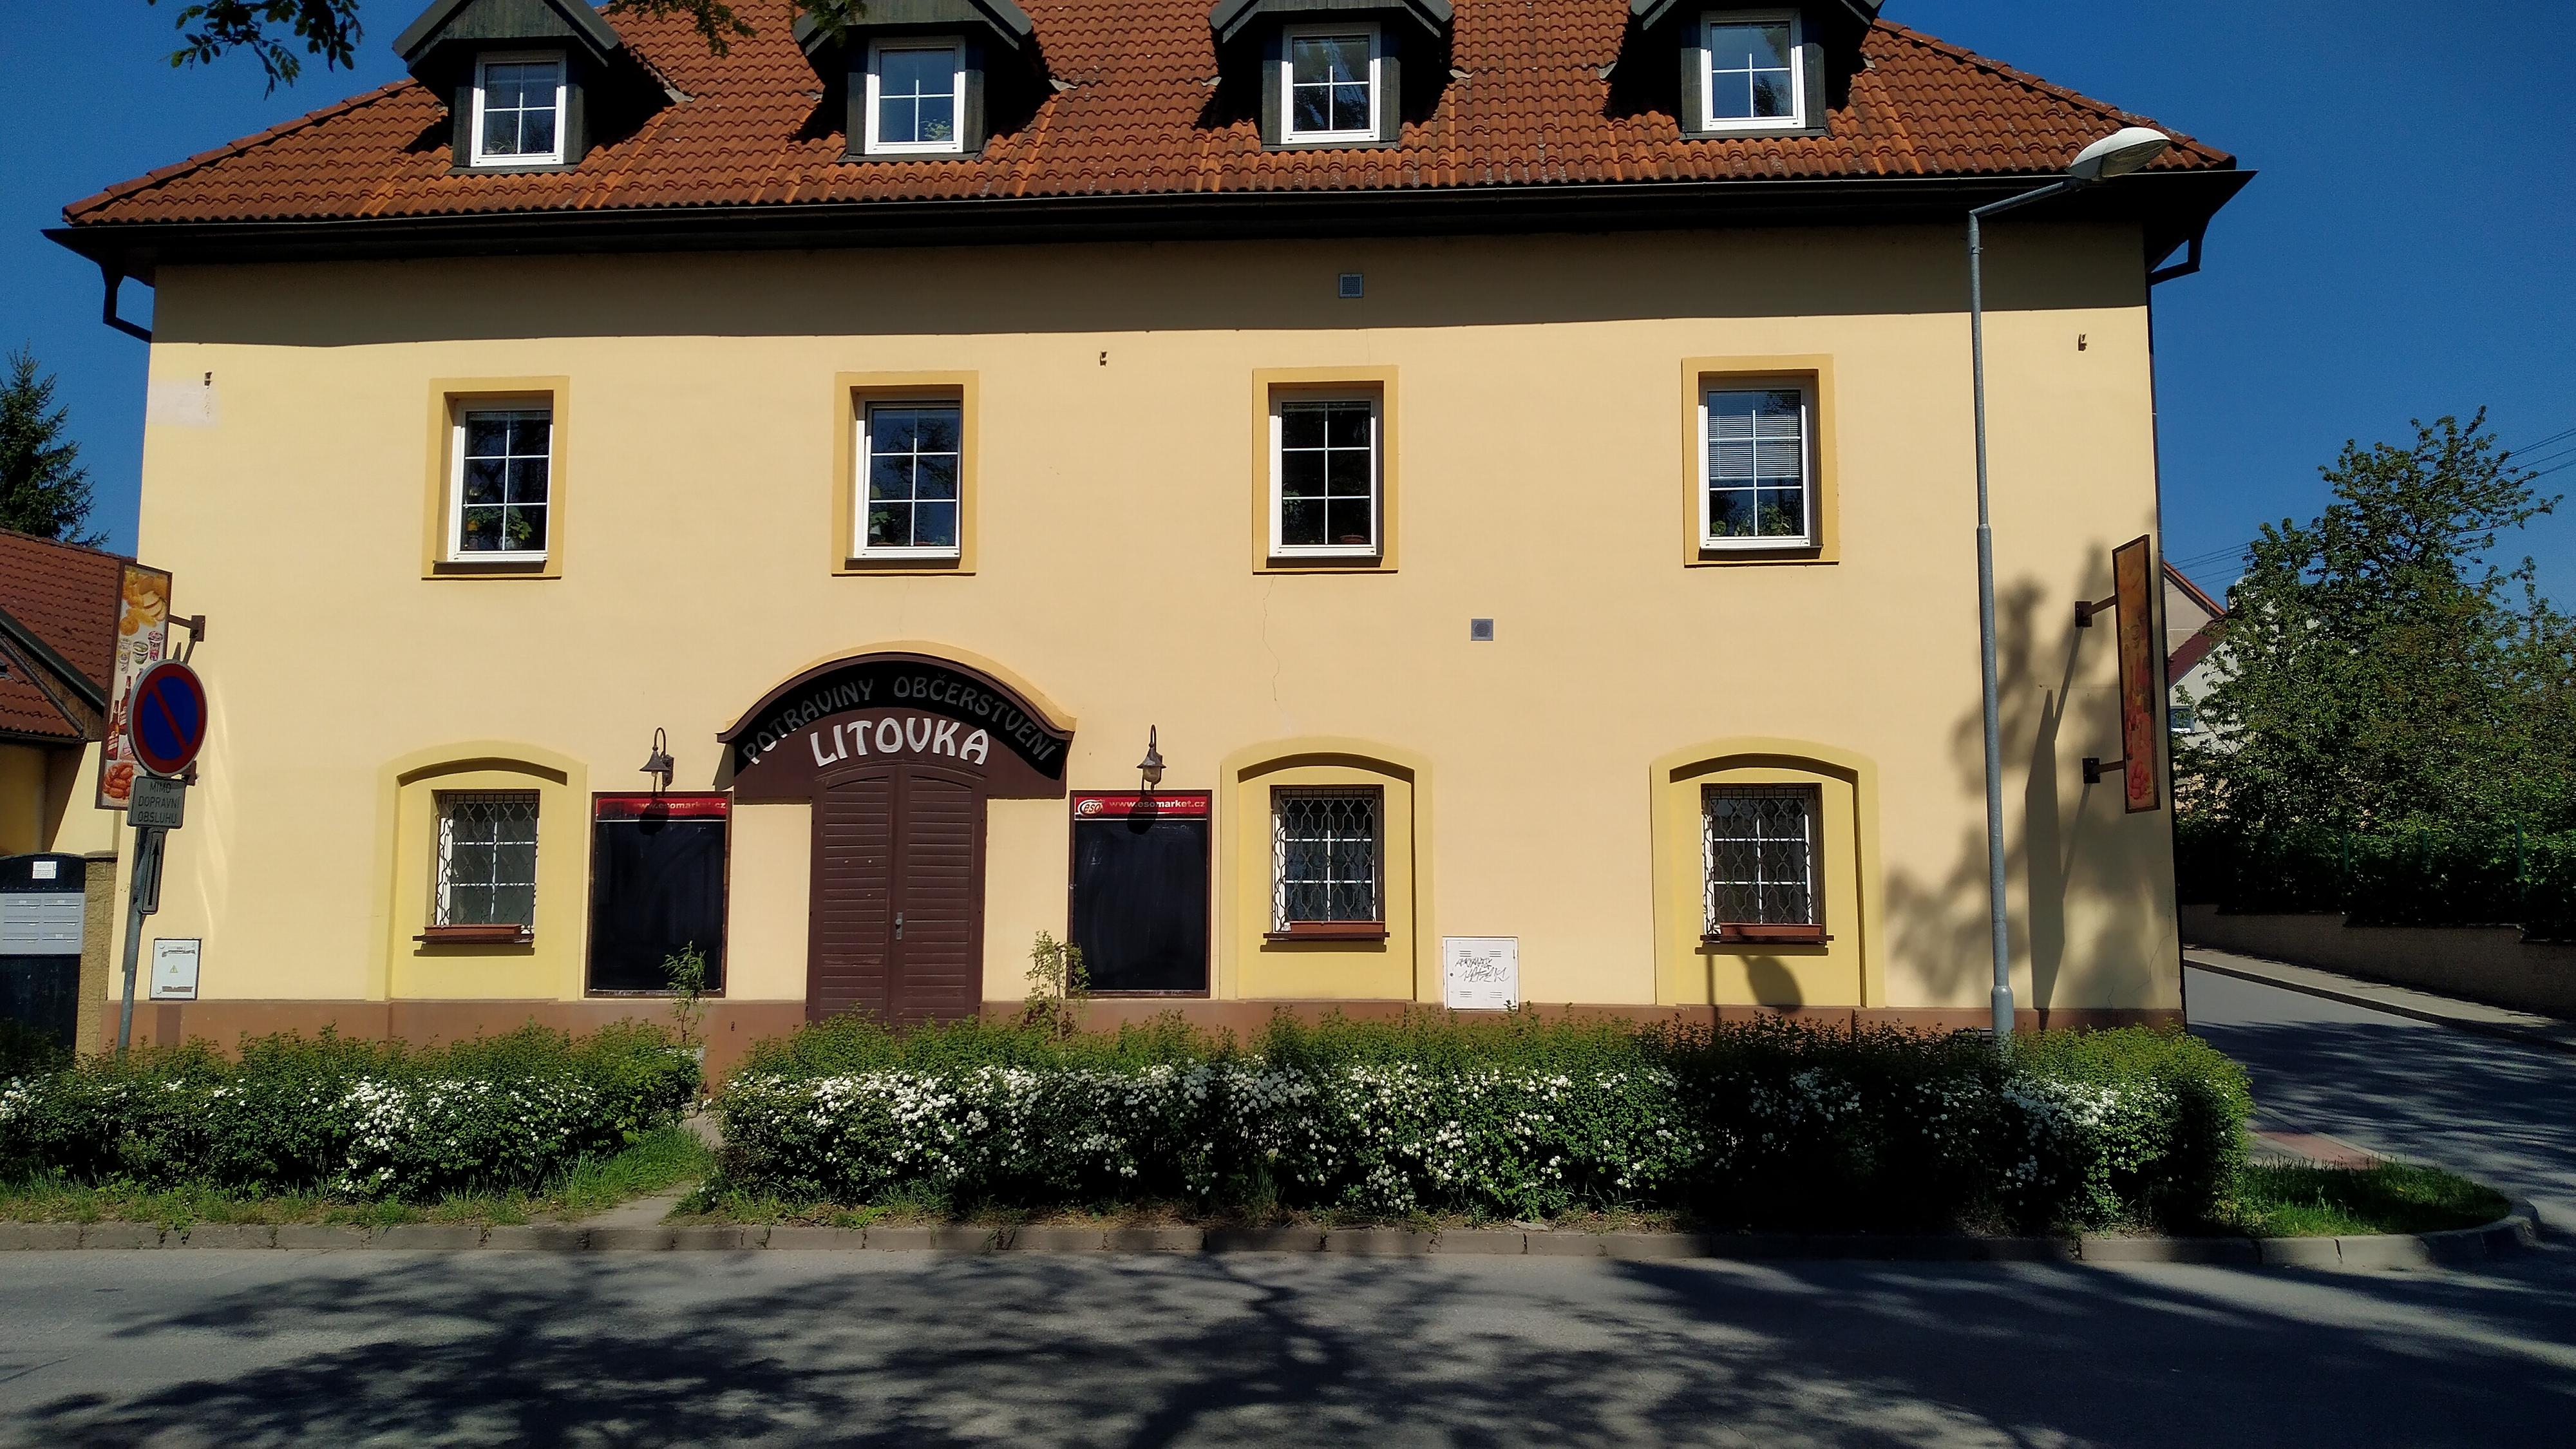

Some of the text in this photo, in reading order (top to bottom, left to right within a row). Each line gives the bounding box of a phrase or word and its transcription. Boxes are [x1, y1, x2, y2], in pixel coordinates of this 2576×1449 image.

[743, 674, 1061, 765] POTRAVINY OBČERSTVENÍ
[810, 717, 989, 767] LITOVKA
[149, 781, 171, 793] MIMO
[138, 795, 181, 808] DOPRAVNÍ
[1083, 804, 1101, 812] eso
[1109, 799, 1206, 808] www.esomarket.cz
[138, 811, 177, 824] OBSLUHU
